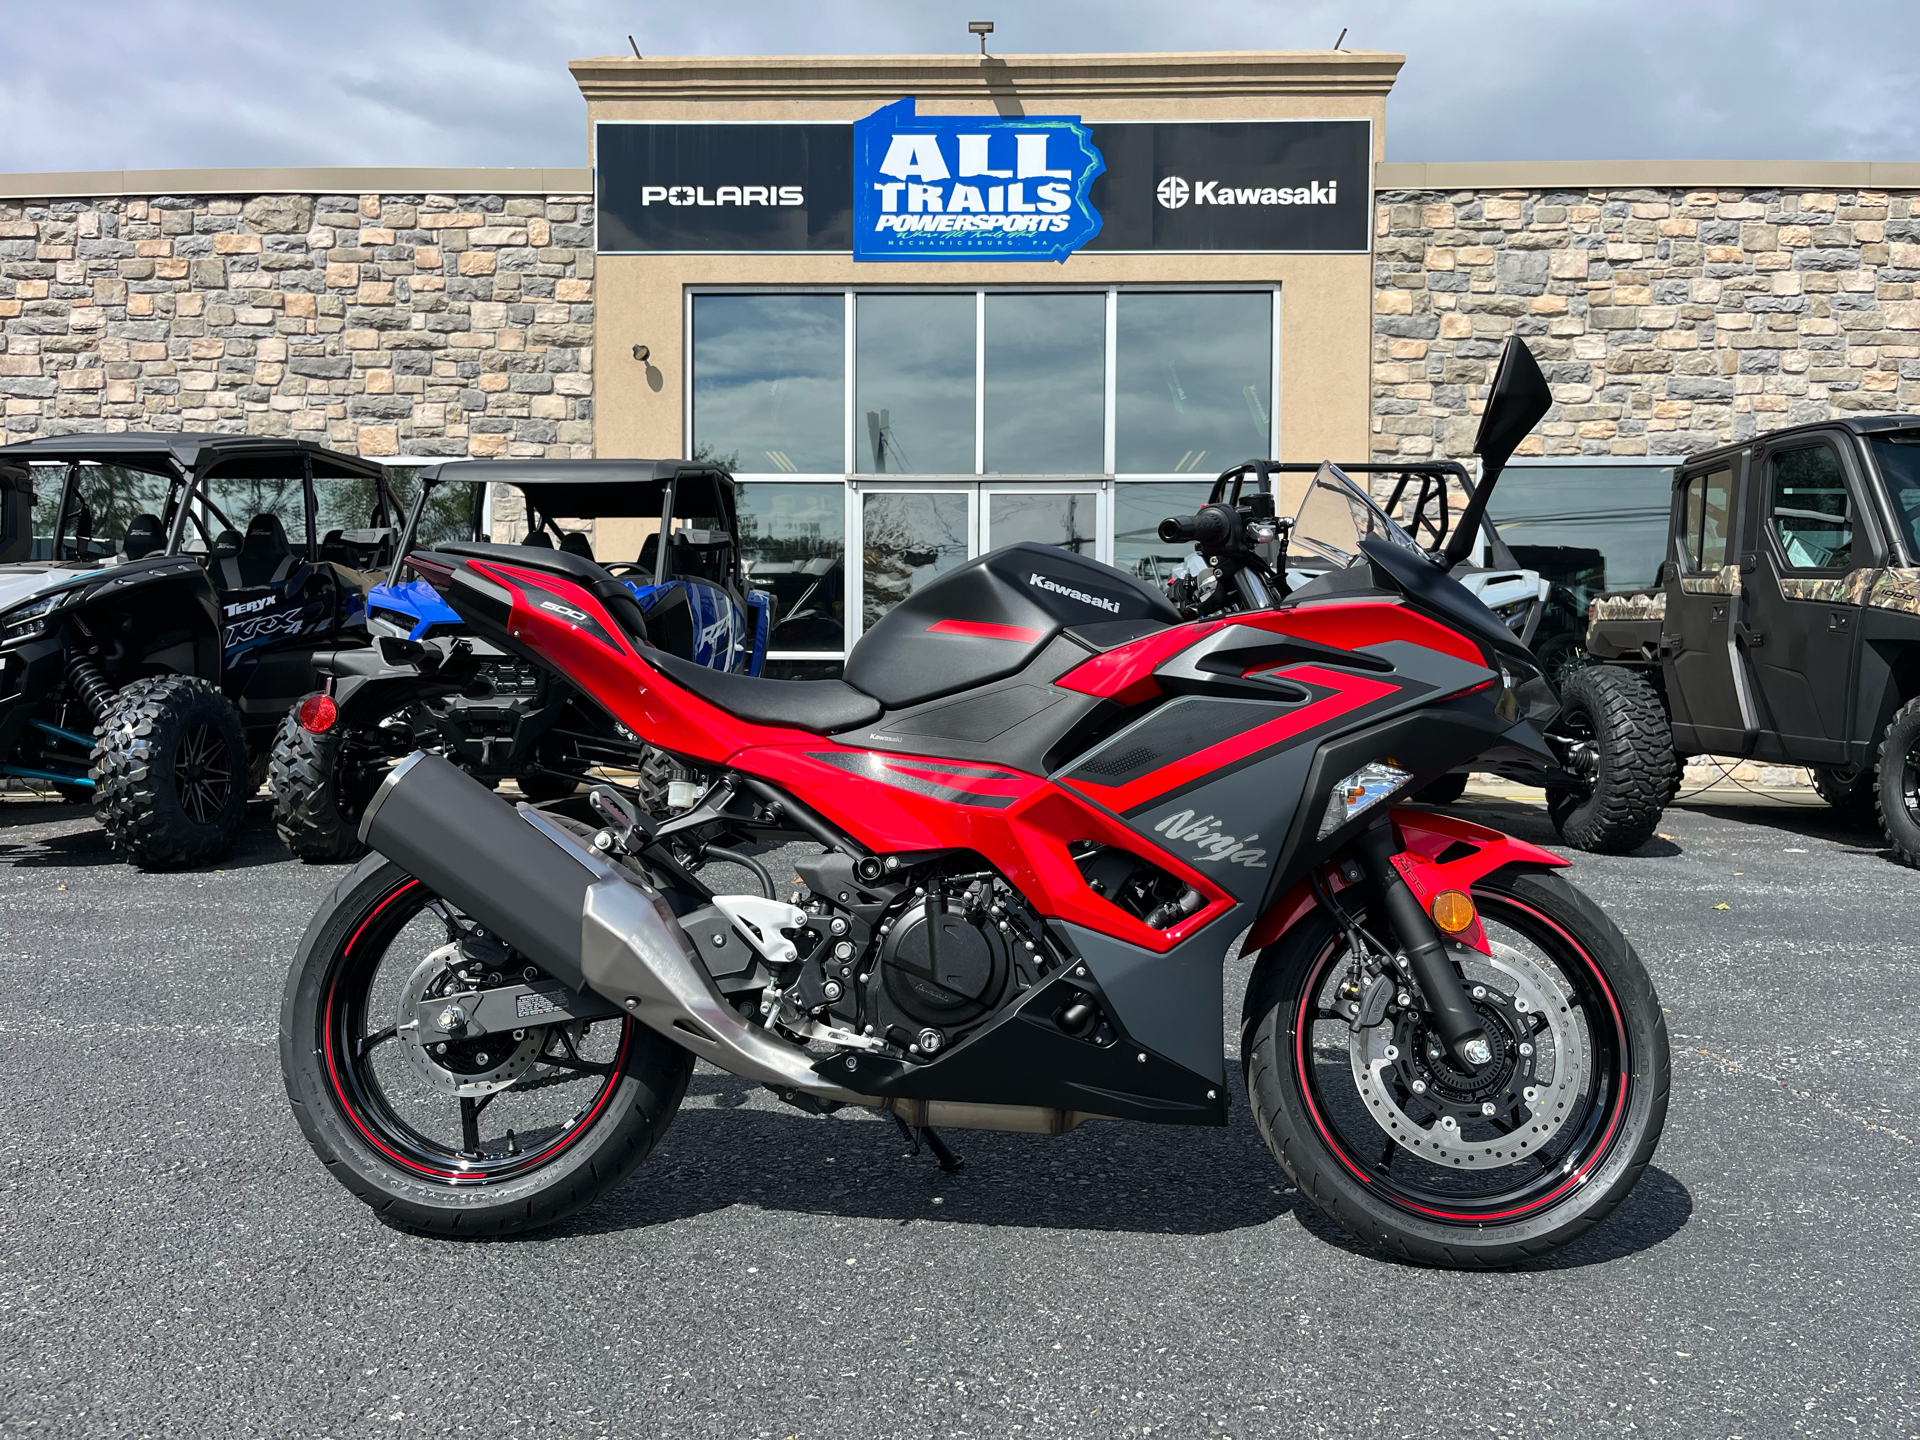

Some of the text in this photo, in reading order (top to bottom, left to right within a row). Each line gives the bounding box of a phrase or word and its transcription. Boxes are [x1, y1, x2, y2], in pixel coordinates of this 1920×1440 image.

[879, 134, 1072, 182] ALL
[641, 185, 804, 206] POLARIS
[874, 182, 1072, 213] TRAILS
[1194, 180, 1337, 205] Kawasaki
[874, 214, 1071, 232] POWERSPORTS
[1029, 573, 1120, 614] Kawasaki
[1881, 590, 1915, 601] 1000
[540, 601, 587, 620] 500
[1607, 606, 1648, 617] RANGER
[869, 733, 903, 743] Kawasaki
[1154, 809, 1267, 868] Ninja
